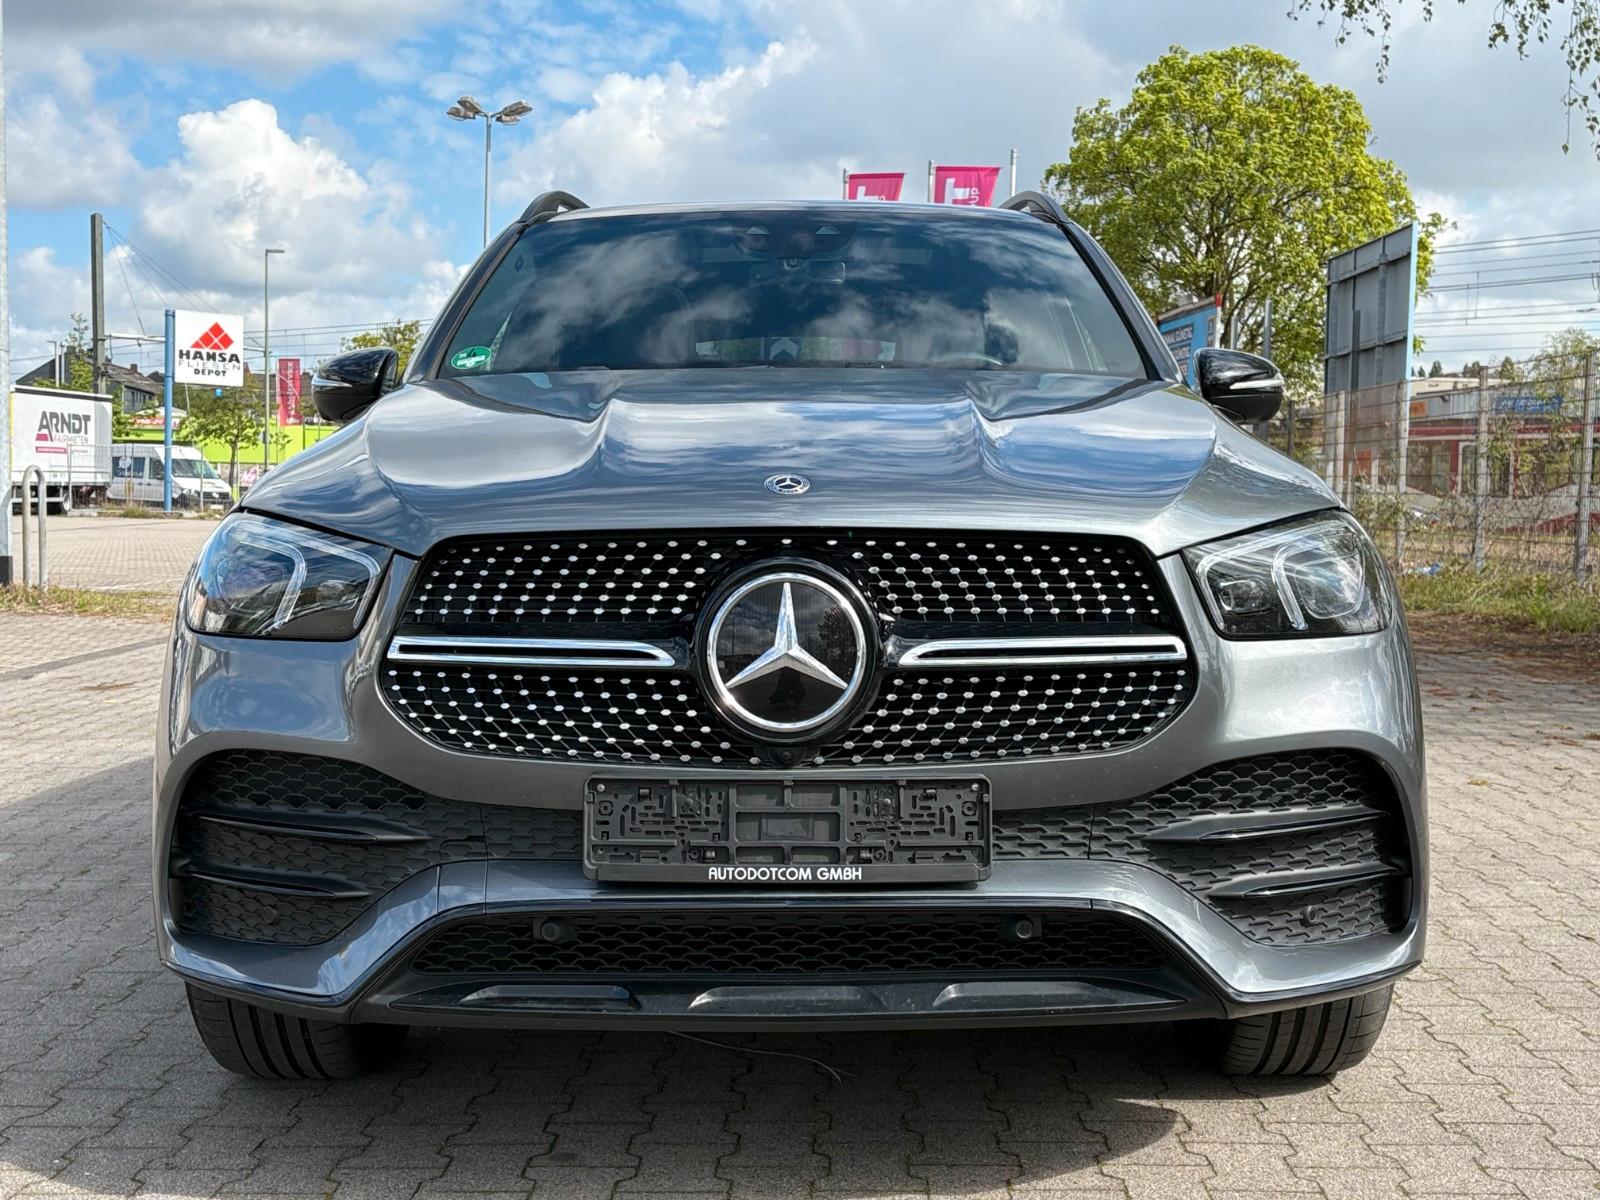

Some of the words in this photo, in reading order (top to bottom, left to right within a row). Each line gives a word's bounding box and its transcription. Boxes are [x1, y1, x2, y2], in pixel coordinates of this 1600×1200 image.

[178, 349, 241, 364] HANSA
[178, 359, 241, 371] FLIESEN
[193, 368, 227, 377] DEPOT
[38, 411, 91, 442] ARNDT
[708, 867, 812, 880] AUTODOTCOM
[816, 867, 862, 880] GMBH
